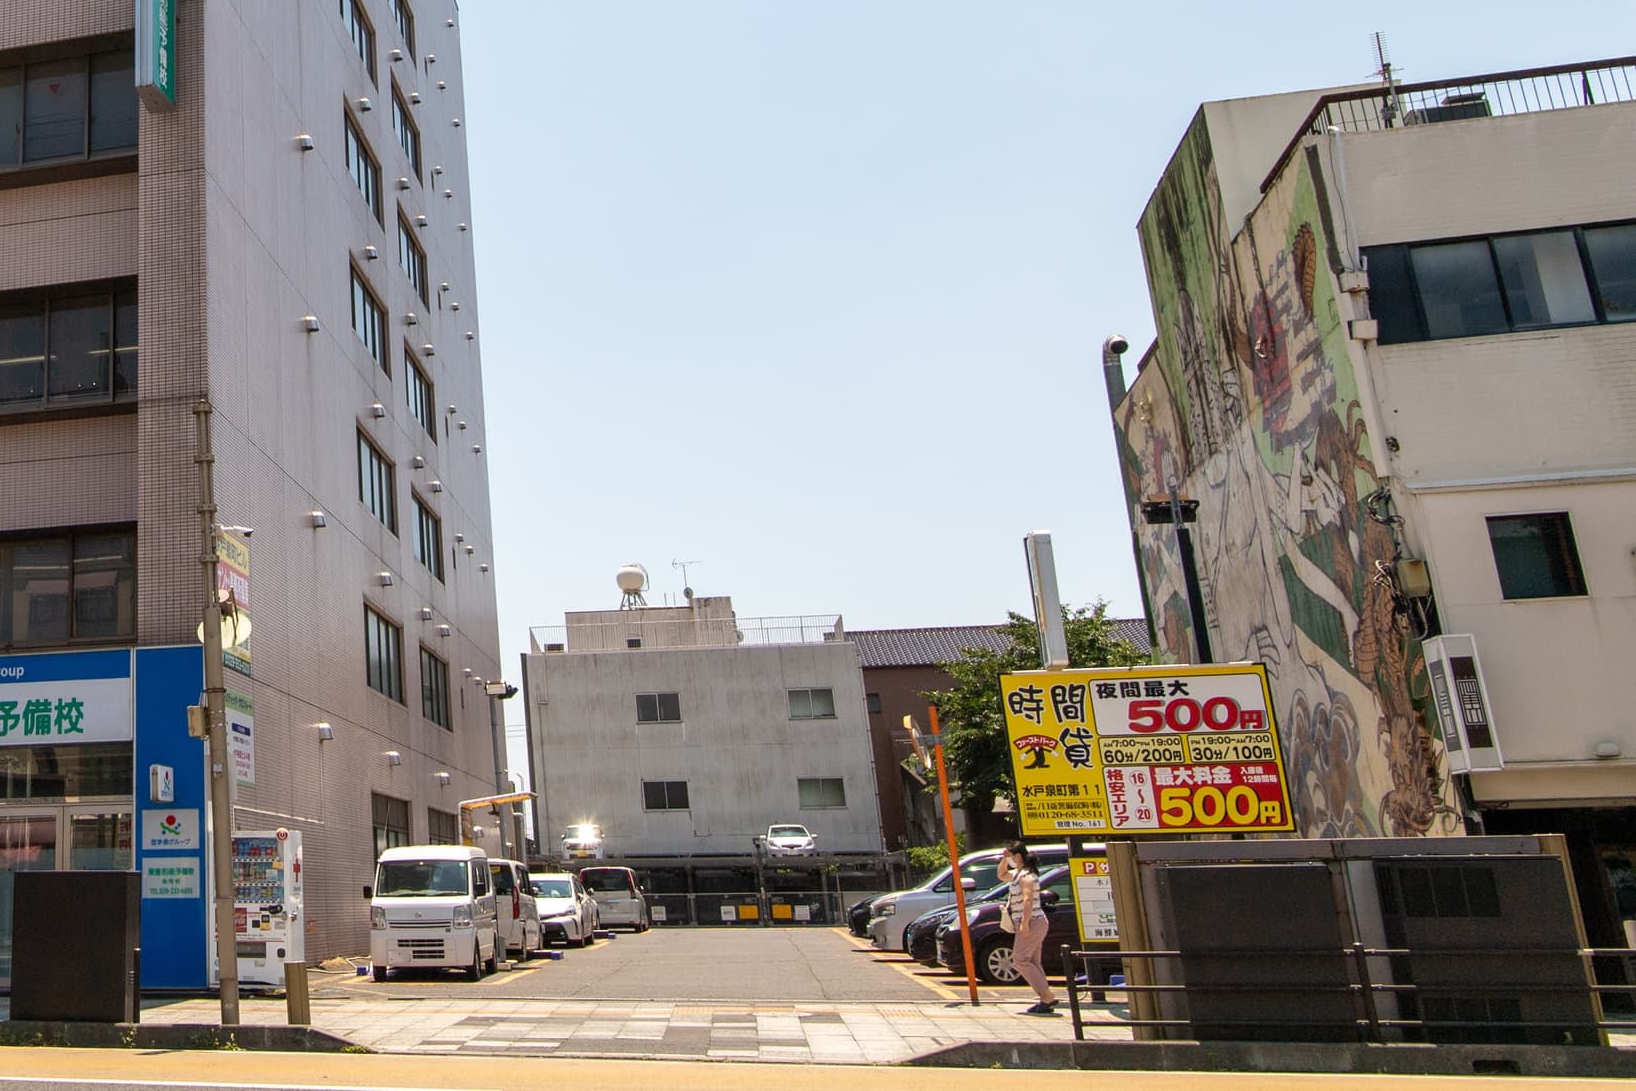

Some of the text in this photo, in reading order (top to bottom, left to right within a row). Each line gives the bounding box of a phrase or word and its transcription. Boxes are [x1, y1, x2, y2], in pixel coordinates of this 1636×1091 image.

[1096, 680, 1189, 699] 夜間最大
[1008, 684, 1085, 724] 時間
[1128, 696, 1264, 733] 500円
[1104, 748, 1182, 763] 60分/200円
[1192, 745, 1273, 760] 30分/100円
[1155, 766, 1232, 786] 最大料金
[1107, 769, 1129, 827] 格安エリア
[1160, 785, 1281, 827] 500円
